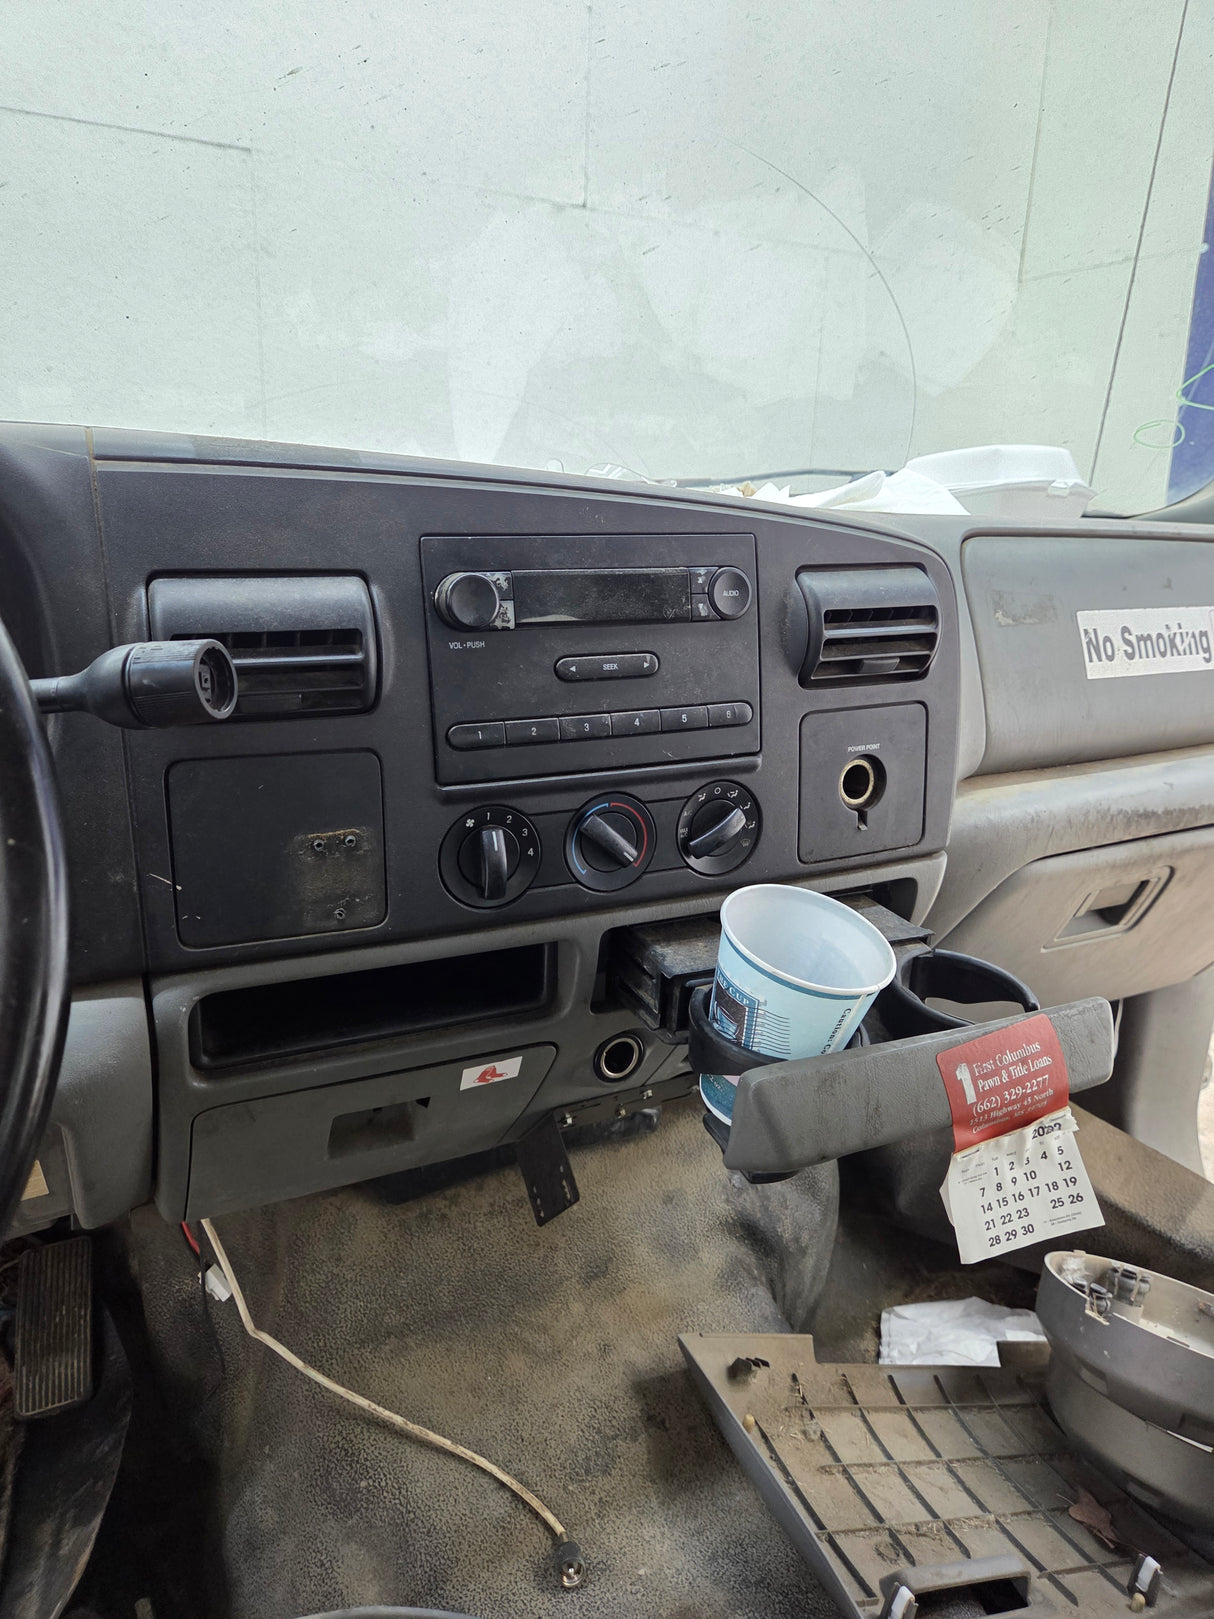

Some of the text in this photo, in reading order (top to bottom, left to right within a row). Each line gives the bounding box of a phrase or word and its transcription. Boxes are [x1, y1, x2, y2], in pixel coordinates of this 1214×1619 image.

[722, 589, 739, 597] AUDIO
[448, 640, 486, 650] VOL PUSH
[1083, 622, 1212, 664] No Smoking
[602, 662, 619, 671] SEEK
[477, 710, 731, 739] 1 2 3 4 5 6
[847, 743, 881, 752] POWER POINT
[506, 815, 512, 824] 2
[522, 828, 528, 836] 3
[527, 847, 534, 856] 4
[728, 986, 750, 1005] CUP
[972, 1041, 1041, 1077] First Columbus
[977, 1055, 1053, 1093] Pawn & Title Loans
[956, 1062, 977, 1105] 1
[972, 1095, 1001, 1116] (662)
[1003, 1075, 1049, 1104] 329-2277
[990, 1102, 1021, 1119] Highway
[1023, 1096, 1032, 1106] 45
[1033, 1088, 1054, 1102] North
[993, 1146, 1064, 1177] 1 2 3 4 5
[979, 1160, 1072, 1197] 7 8 9 10 12
[981, 1176, 1077, 1214] 14 15 16 17 18 19
[984, 1219, 996, 1231] 21
[1000, 1213, 1013, 1225] 22
[1016, 1207, 1030, 1220] 23
[1050, 1197, 1065, 1209] 25
[1068, 1193, 1084, 1204] 26
[988, 1224, 1035, 1247] 28 29 30
